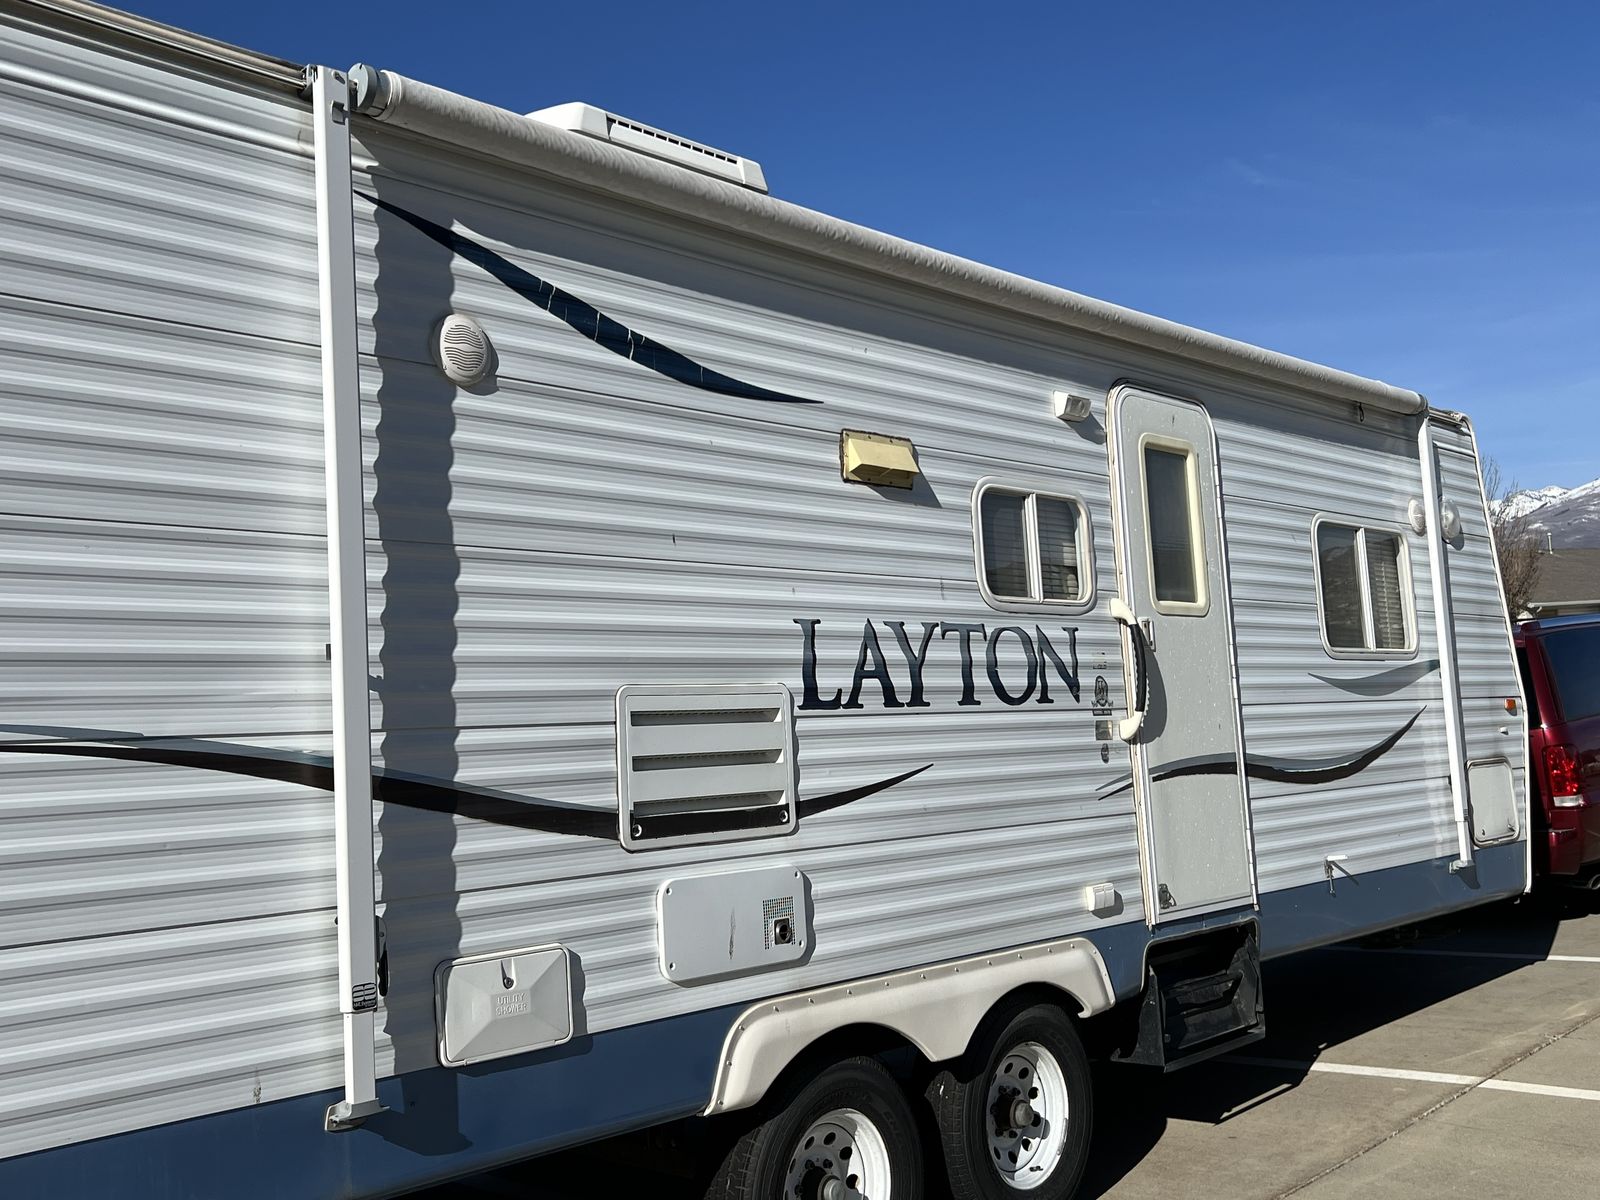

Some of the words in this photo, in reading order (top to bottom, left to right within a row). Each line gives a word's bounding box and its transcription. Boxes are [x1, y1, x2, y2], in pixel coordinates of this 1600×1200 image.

[793, 618, 1080, 710] LAYTON
[496, 992, 526, 1005] UTILITY
[495, 1003, 528, 1016] SHOWER
